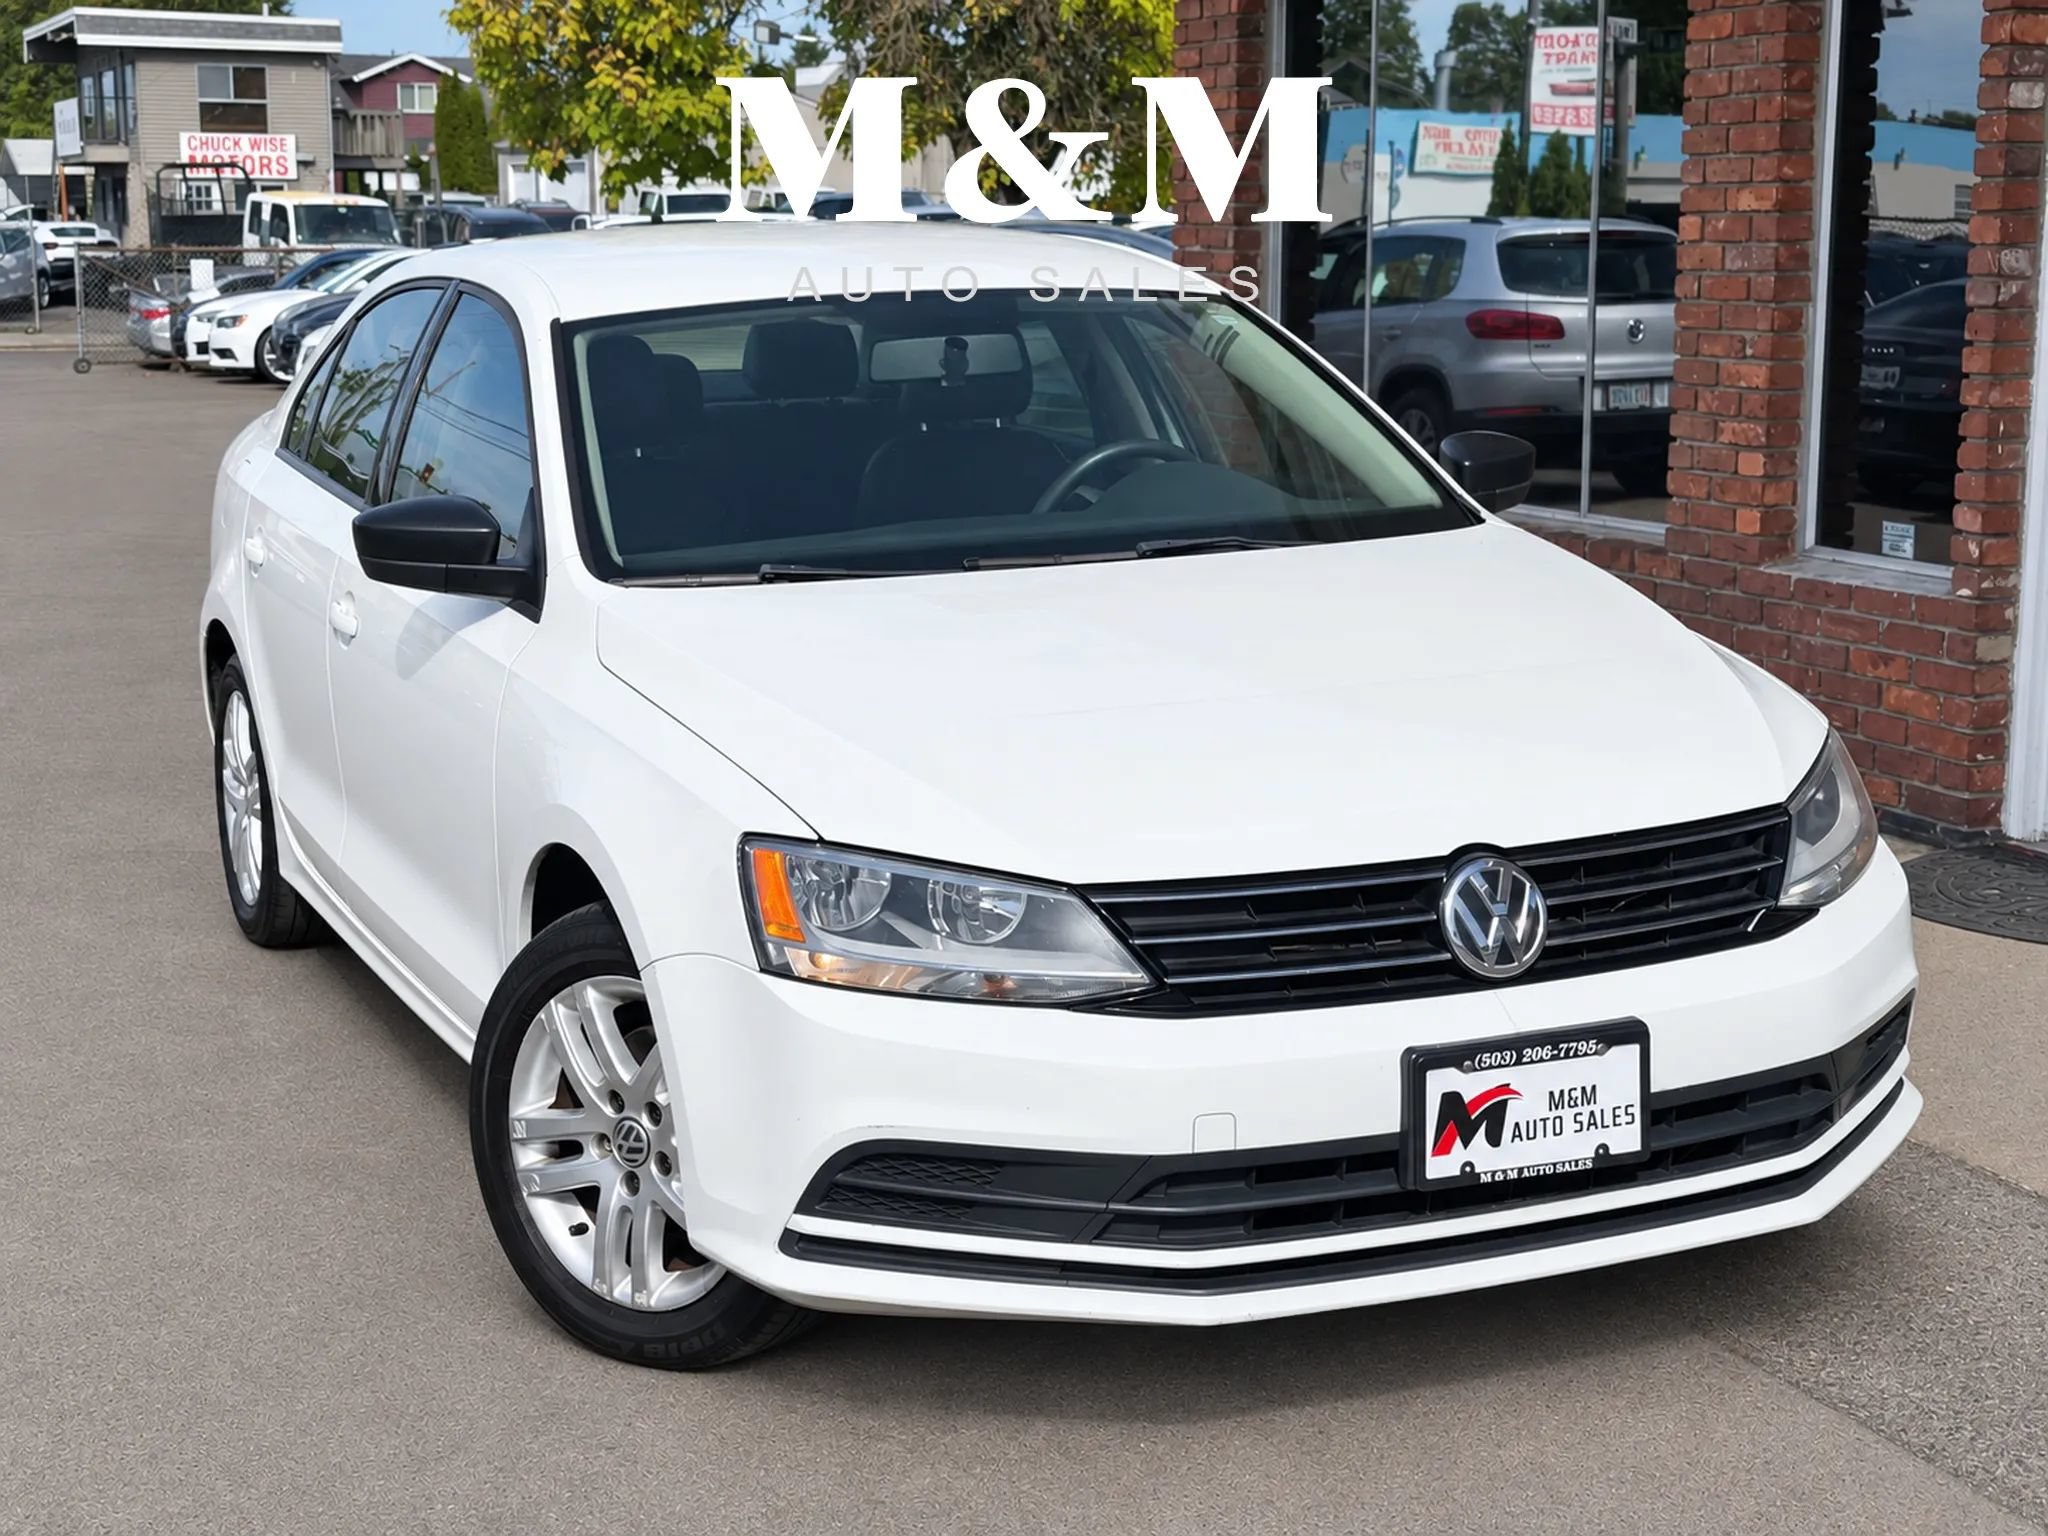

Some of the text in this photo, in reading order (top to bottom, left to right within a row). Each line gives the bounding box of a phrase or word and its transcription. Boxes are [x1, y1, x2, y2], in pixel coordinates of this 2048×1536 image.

[187, 135, 288, 152] CHUCK WISE
[188, 154, 289, 176] MOTORS
[1474, 1039, 1597, 1070] (503) 206-7795
[1548, 1084, 1598, 1112] M&M
[1511, 1104, 1636, 1143] AUTO SALES
[1521, 1164, 1554, 1178] AUTO
[1555, 1158, 1593, 1173] SALES
